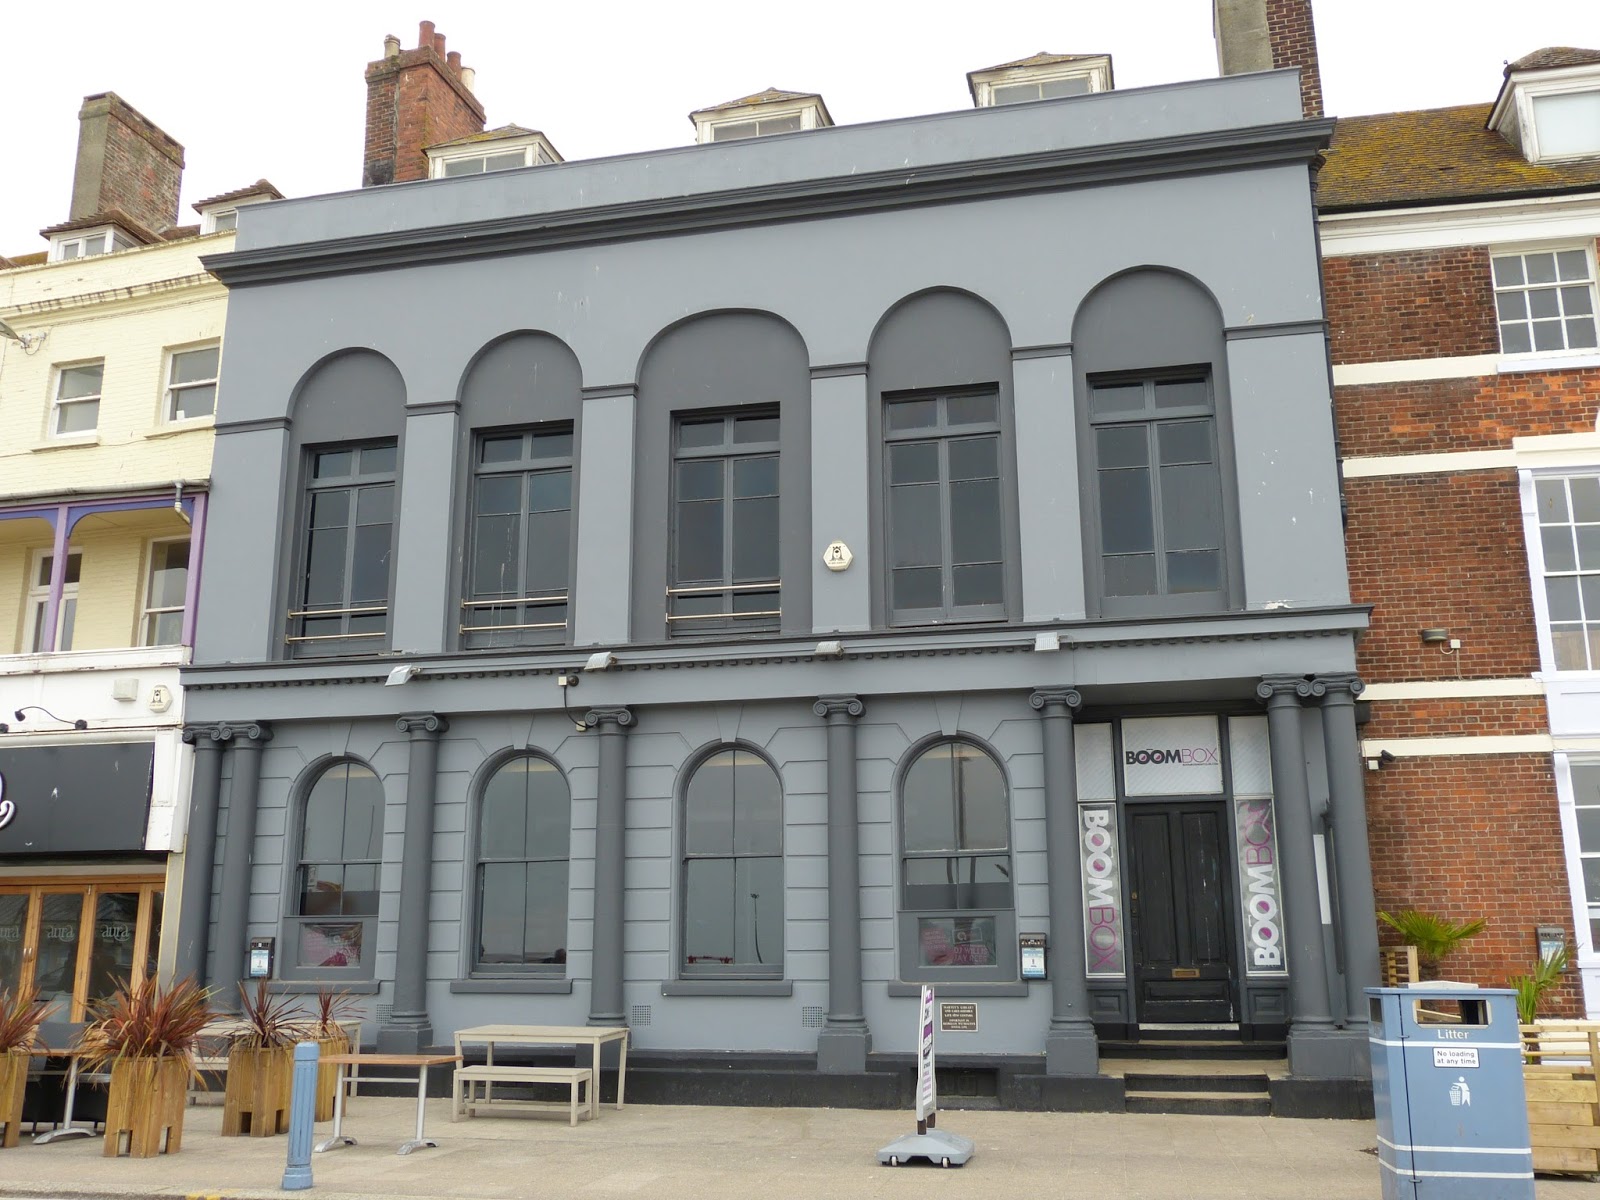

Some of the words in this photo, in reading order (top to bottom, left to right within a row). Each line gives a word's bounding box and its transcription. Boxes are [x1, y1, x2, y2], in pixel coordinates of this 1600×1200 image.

[1084, 810, 1118, 970] BOOMBOX
[0, 925, 20, 942] ura
[47, 925, 75, 942] aura
[101, 924, 130, 942] aura
[1437, 1029, 1469, 1039] Litter
[1449, 1050, 1475, 1058] loading
